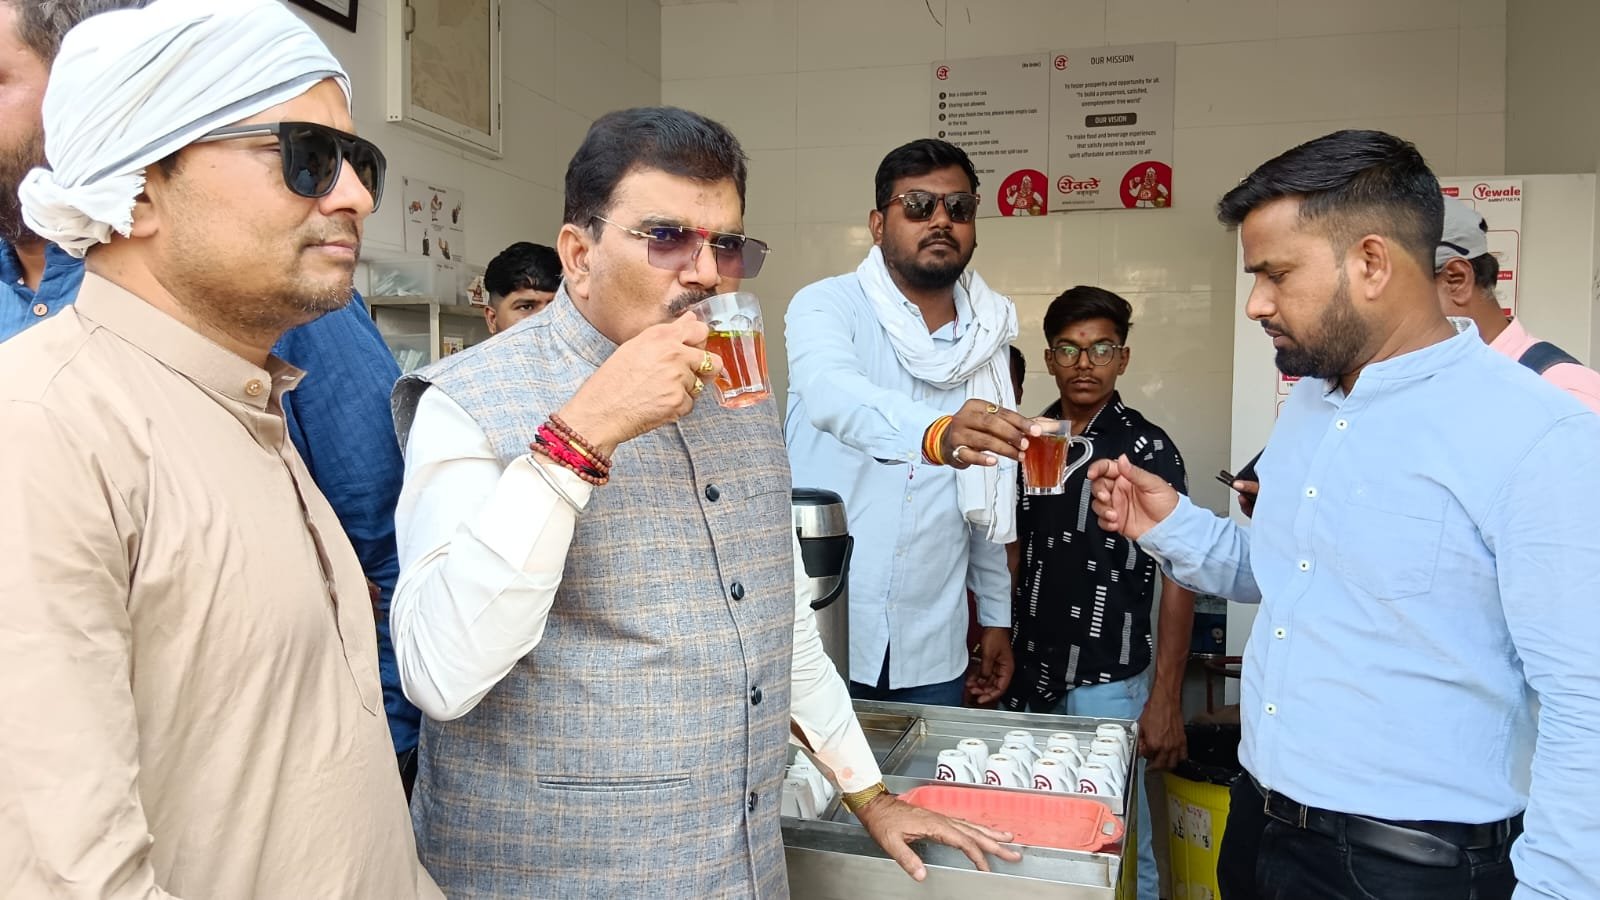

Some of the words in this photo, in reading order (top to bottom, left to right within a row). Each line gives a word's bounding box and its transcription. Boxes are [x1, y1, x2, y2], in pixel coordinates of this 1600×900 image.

[1091, 57, 1105, 65] OUR
[1106, 54, 1135, 64] MISSION
[1085, 81, 1107, 89] prosperity
[1118, 78, 1145, 87] opportunity
[1108, 115, 1127, 123] VISION
[1128, 130, 1156, 138] experiences
[1086, 141, 1102, 149] satisfy
[1102, 141, 1118, 149] people
[1124, 139, 1136, 148] body
[1057, 175, 1101, 194] येवले
[1474, 184, 1520, 199] Yewale
